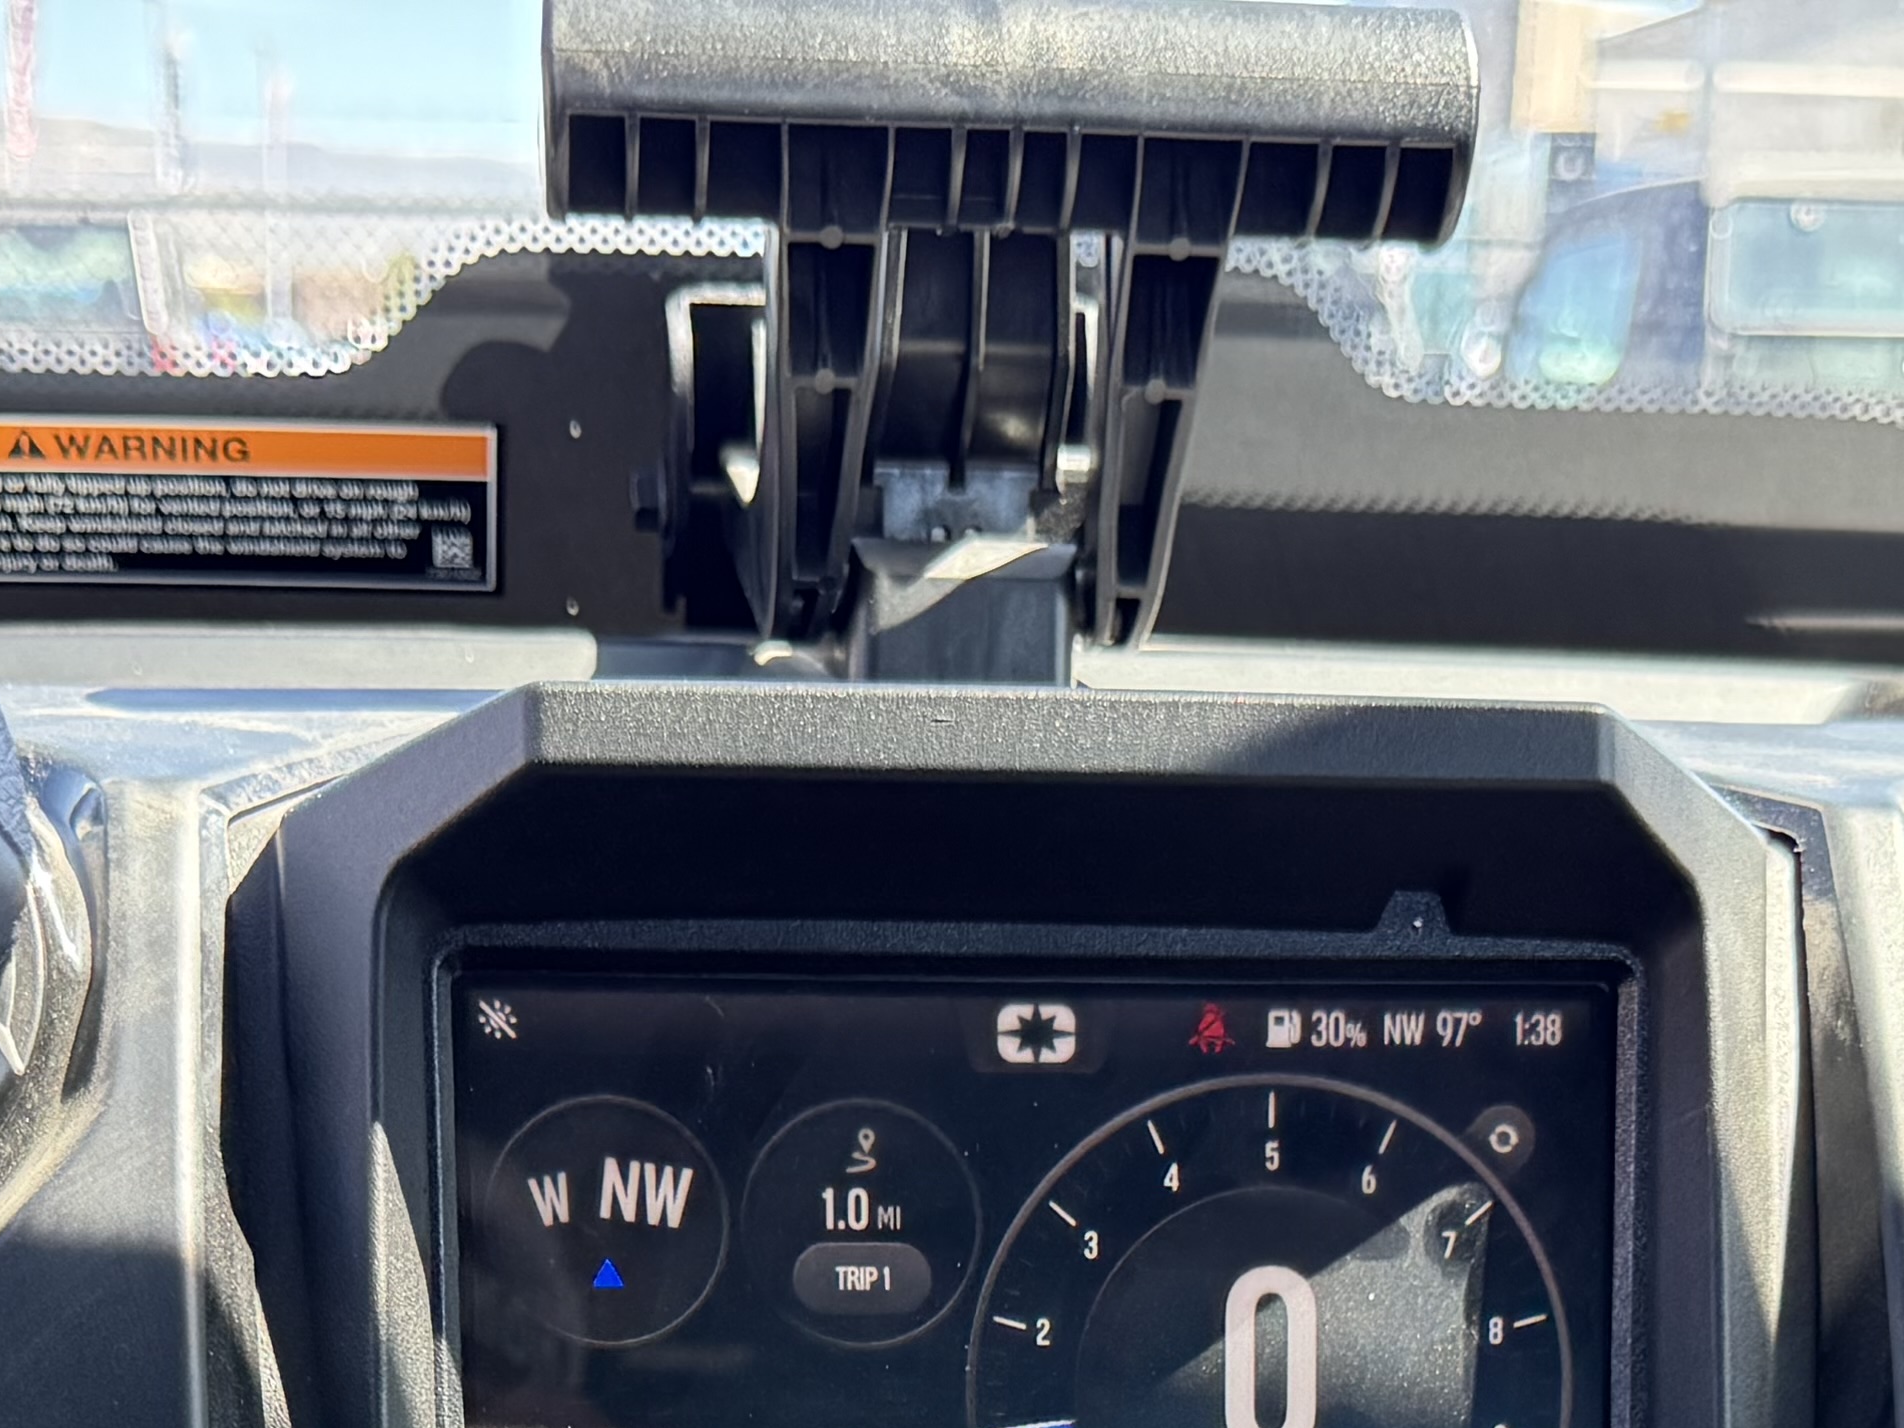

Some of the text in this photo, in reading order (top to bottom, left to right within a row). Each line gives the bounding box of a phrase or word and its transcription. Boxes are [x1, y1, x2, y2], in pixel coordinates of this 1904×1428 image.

[53, 434, 250, 464] WARNING
[1311, 1011, 1563, 1048] 30% NW 97° 1:38
[1264, 1142, 1280, 1170] 5
[1164, 1163, 1180, 1192] 4
[1361, 1166, 1376, 1195] 6
[527, 1156, 694, 1230] W NW
[822, 1187, 902, 1232] 1.0 MI
[1084, 1231, 1099, 1260] 3
[1442, 1231, 1457, 1259] 7
[835, 1266, 891, 1292] TRIP 1
[1035, 1318, 1051, 1346] 2
[1488, 1317, 1504, 1345] 8
